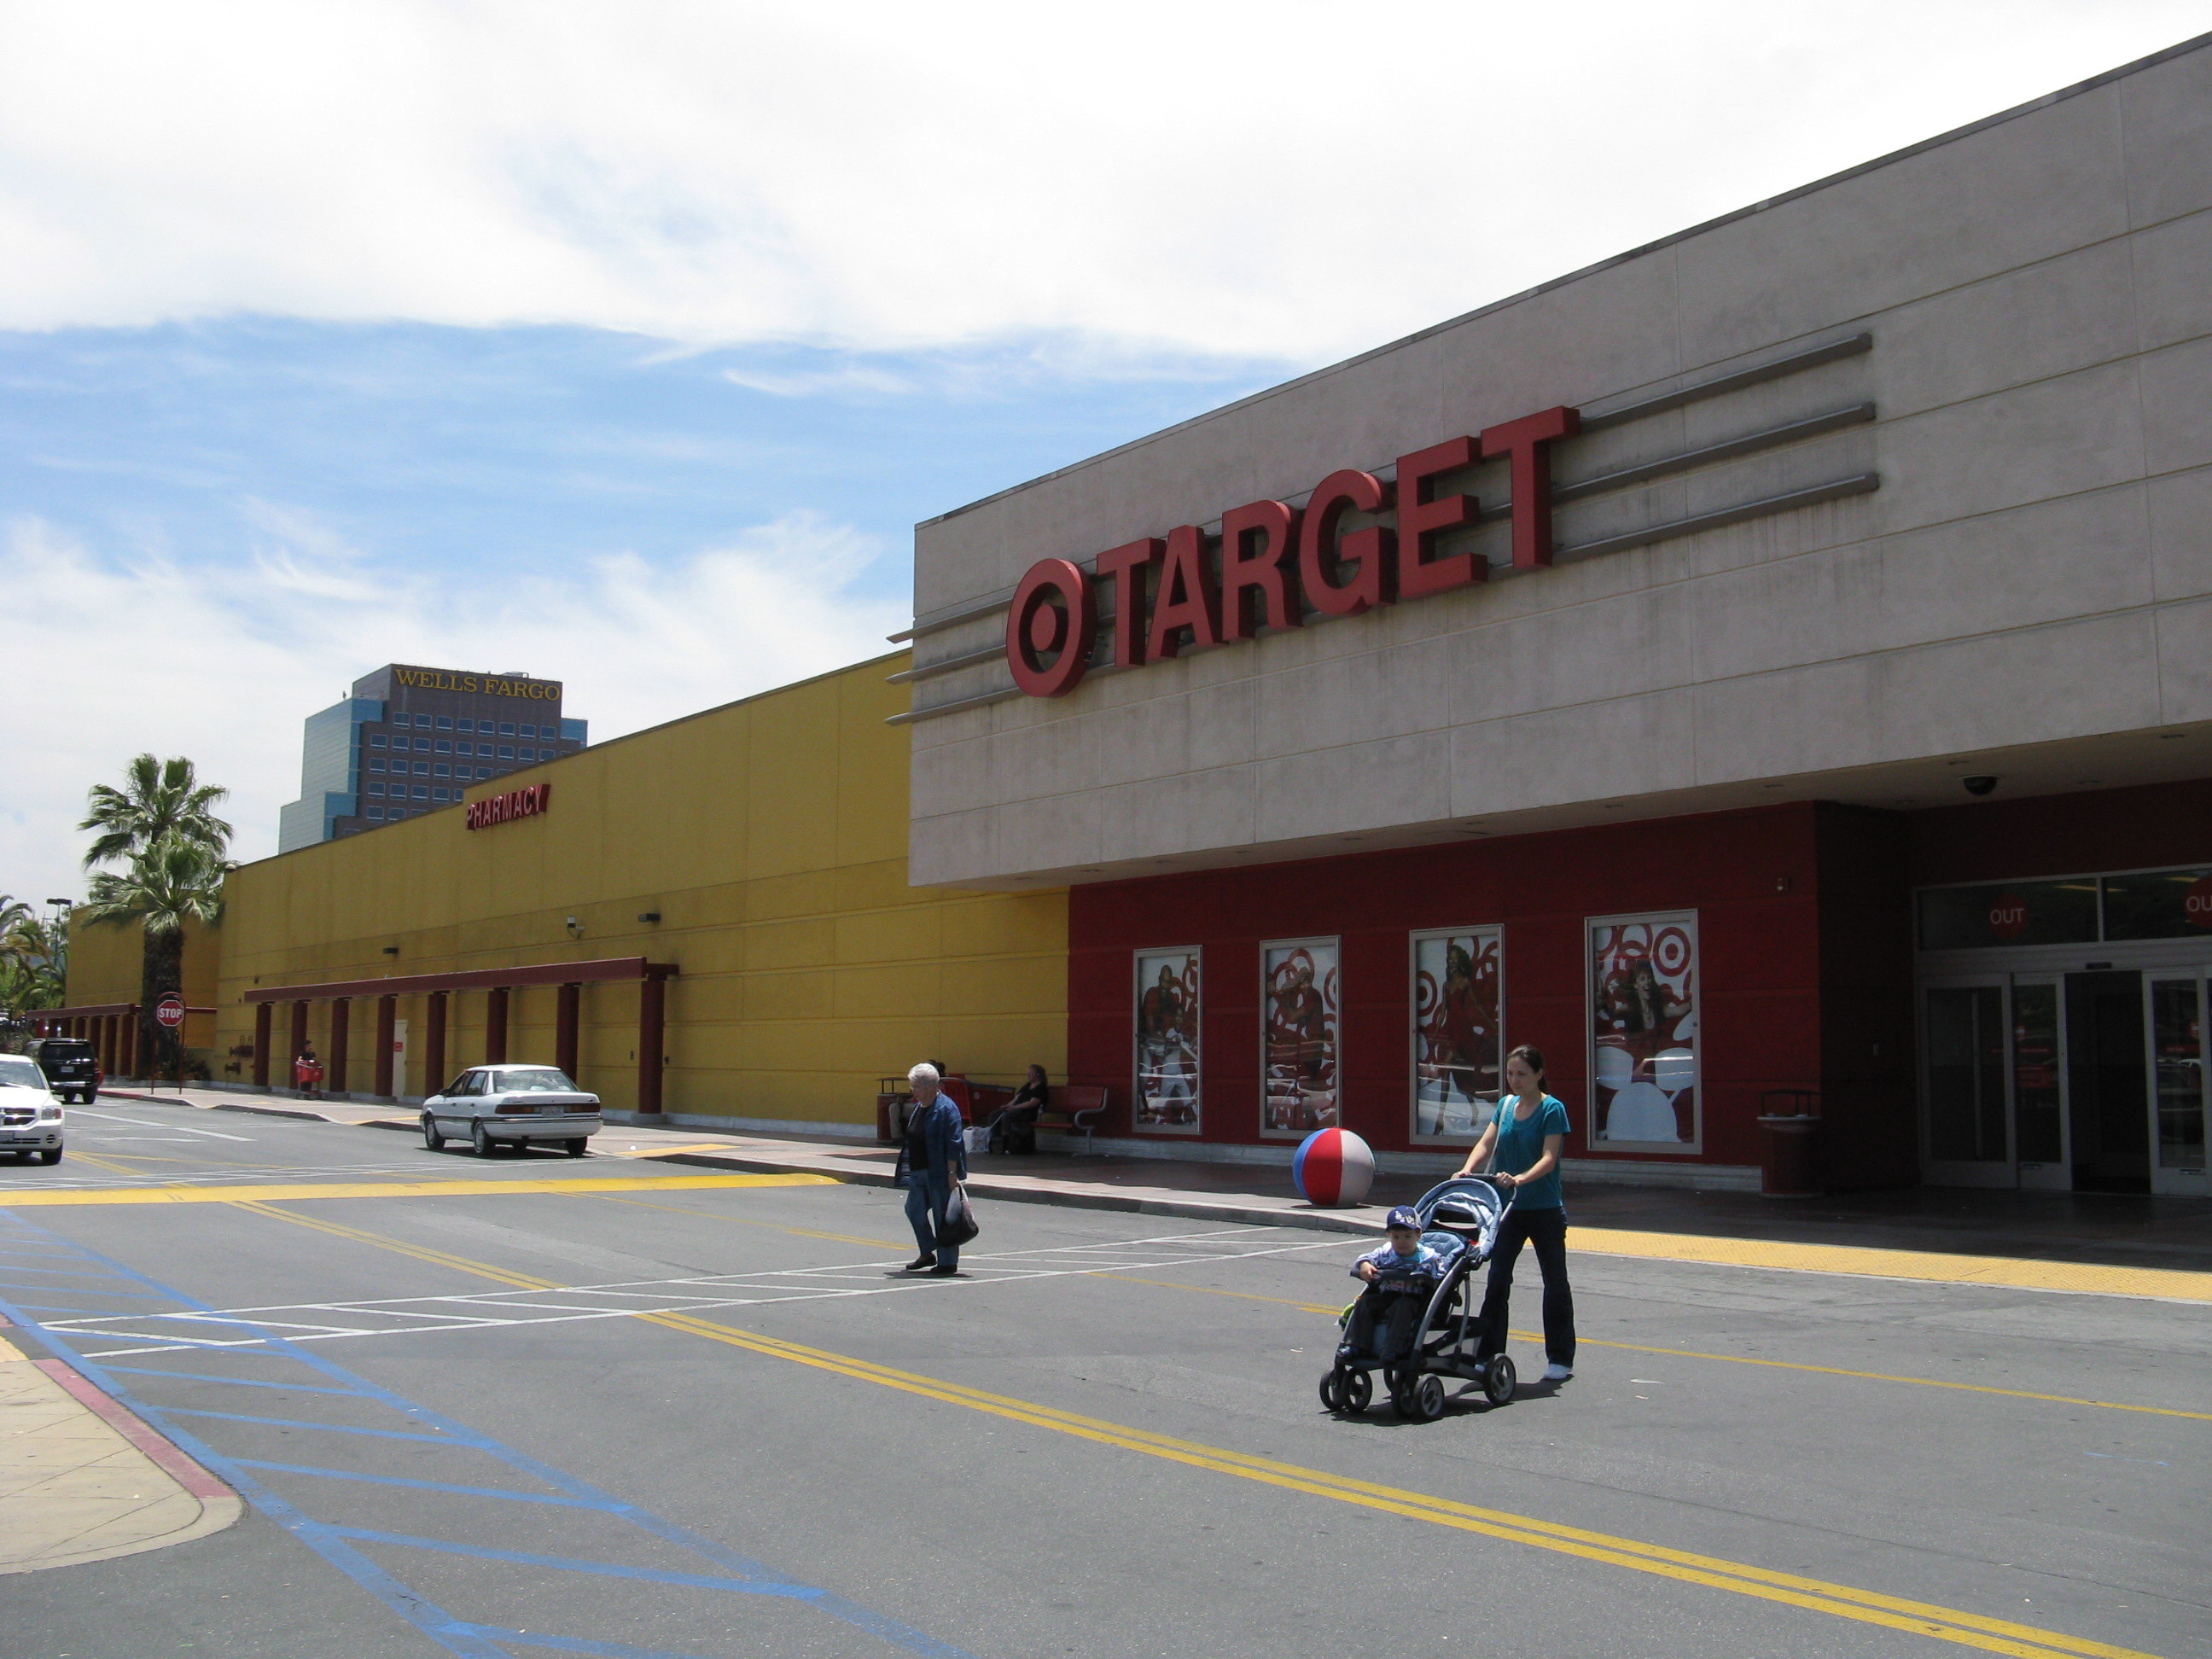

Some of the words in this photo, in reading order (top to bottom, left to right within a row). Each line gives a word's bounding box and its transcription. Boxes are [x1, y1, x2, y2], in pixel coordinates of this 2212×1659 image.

[1096, 405, 1580, 667] TARGET
[395, 669, 478, 693] WELLS
[484, 679, 560, 701] FARGO
[467, 783, 549, 830] PHARMACY
[1990, 908, 2024, 924] OUT
[160, 1008, 183, 1018] STOP
